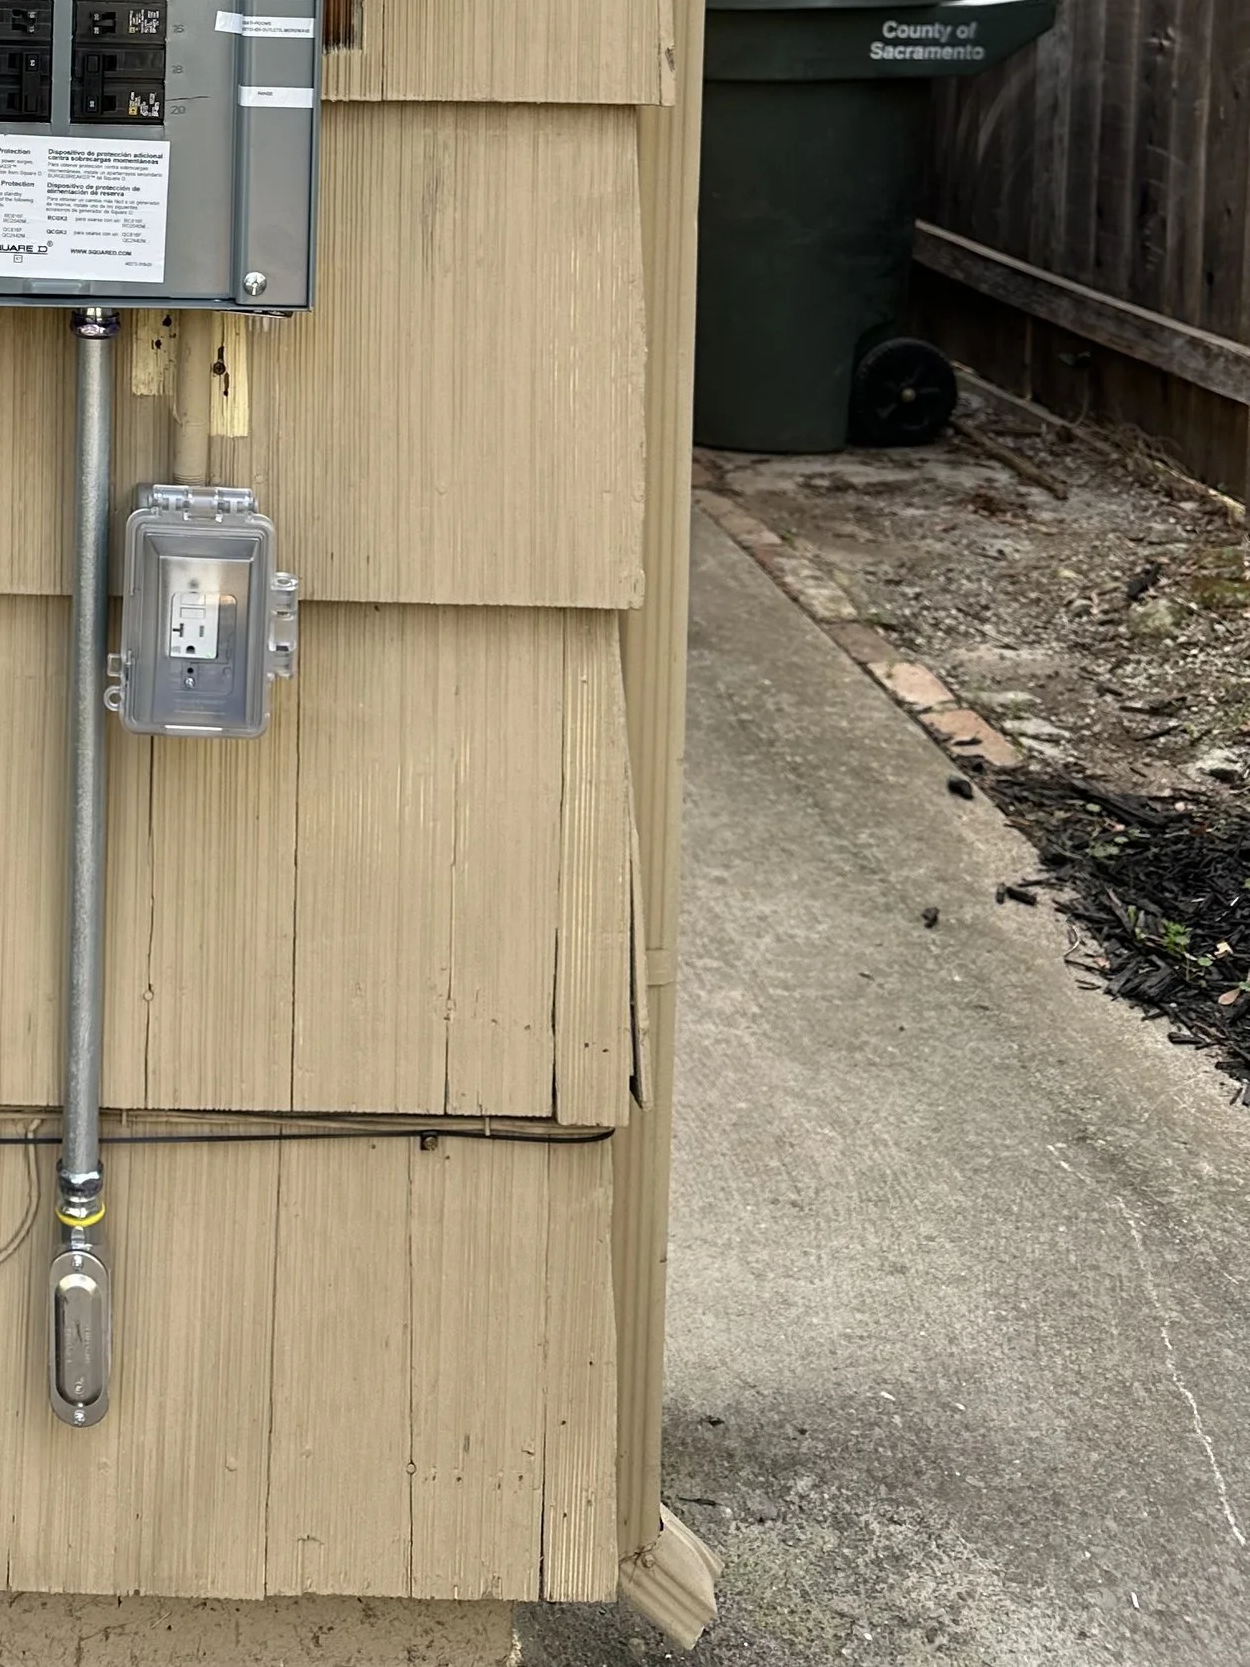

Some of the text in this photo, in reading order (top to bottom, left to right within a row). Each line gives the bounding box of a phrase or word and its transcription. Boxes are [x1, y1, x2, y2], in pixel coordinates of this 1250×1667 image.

[882, 20, 978, 43] County of
[869, 41, 986, 60] Sacramento
[71, 156, 111, 164] sobrecargas
[46, 182, 84, 190] Dispositivo
[38, 245, 48, 253] D
